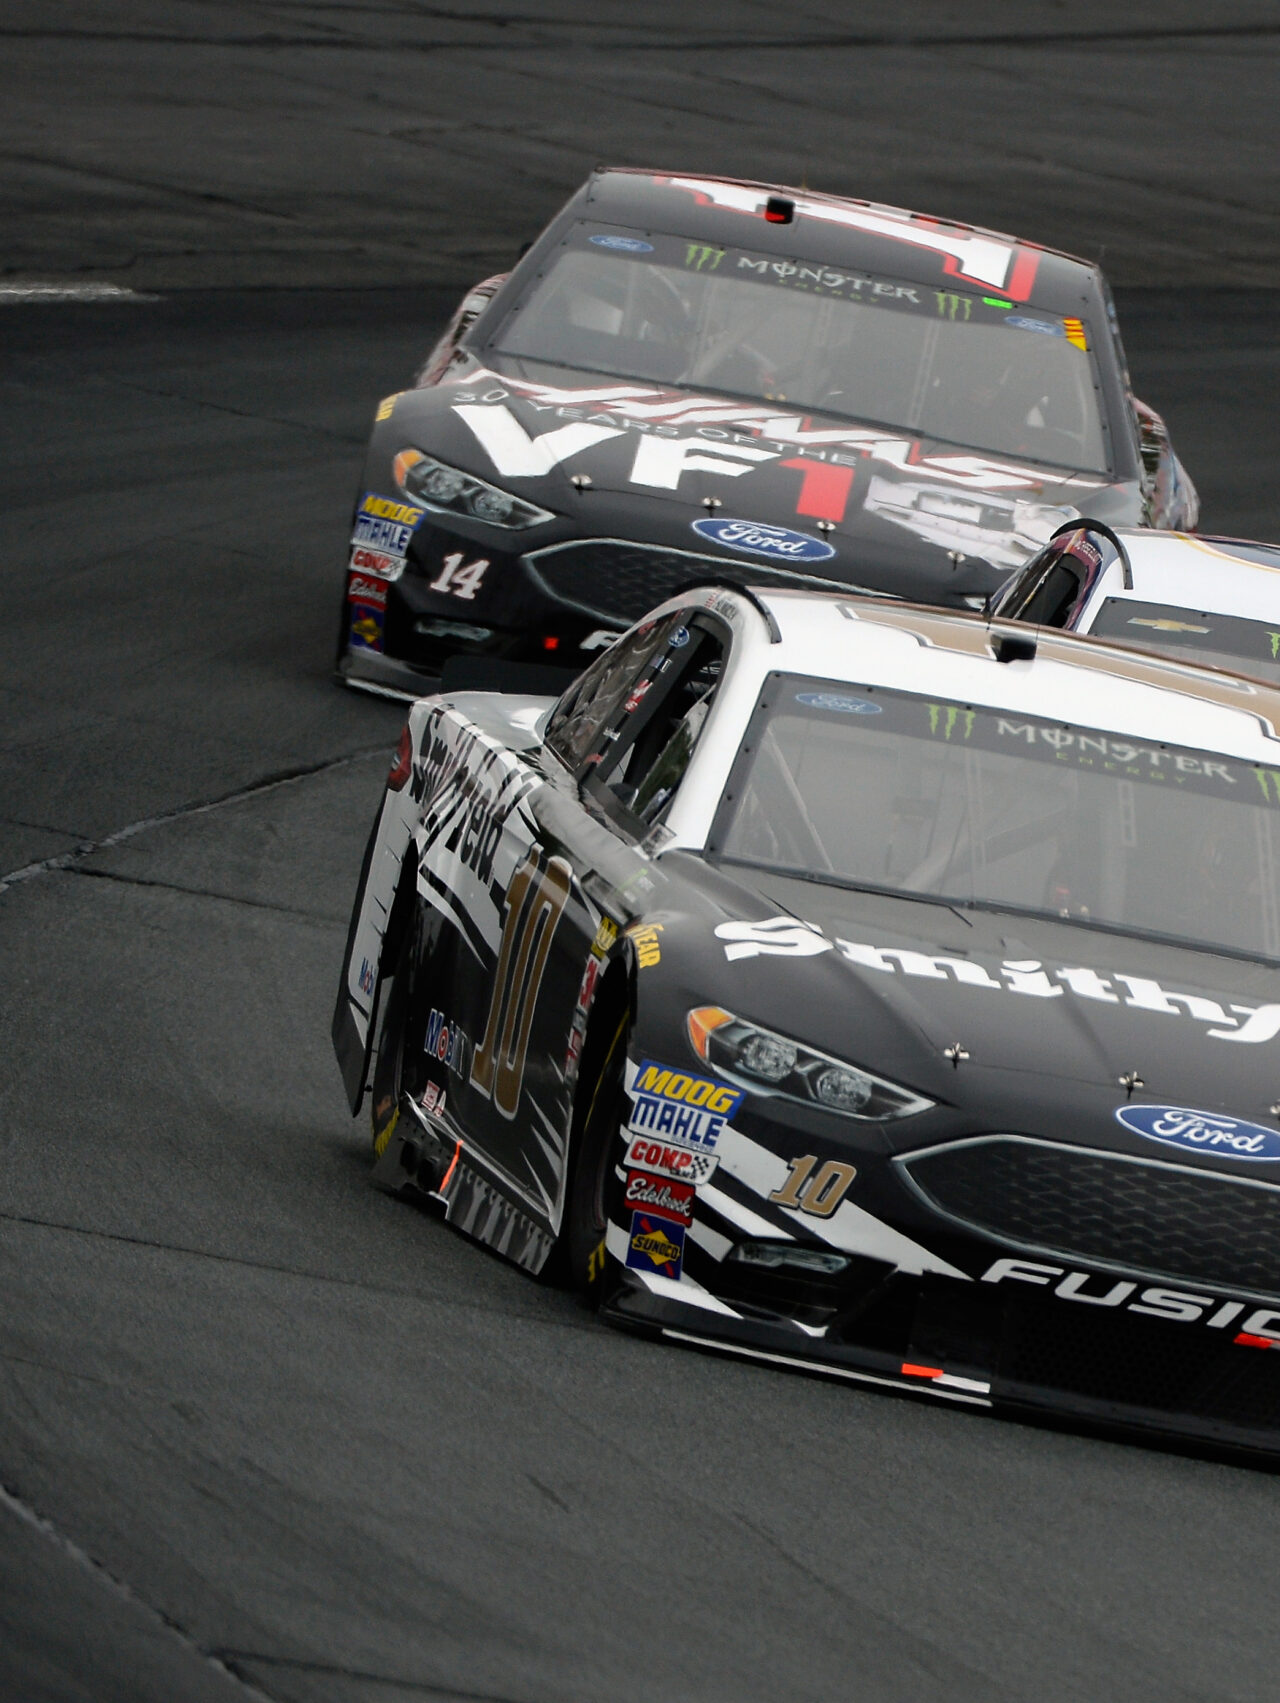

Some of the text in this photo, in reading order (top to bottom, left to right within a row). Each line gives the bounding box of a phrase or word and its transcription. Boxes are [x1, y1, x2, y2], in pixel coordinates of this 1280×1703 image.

[738, 256, 920, 303] MONSTER
[526, 399, 680, 437] YEARS
[696, 427, 757, 446] OF
[777, 442, 858, 467] THE
[362, 495, 424, 526] MOOG
[354, 518, 409, 552] MAHLE
[717, 519, 808, 554] Ford
[429, 553, 491, 600] 14
[996, 717, 1237, 783] MONSTER
[1055, 751, 1187, 784] ENERGY
[637, 1065, 741, 1114] MOOG
[632, 1096, 727, 1148] MAHLE
[1152, 1109, 1265, 1154] Ford
[630, 1140, 693, 1169] COMP
[626, 1178, 691, 1217] Edelbrock
[768, 1153, 858, 1219] 10
[633, 1235, 680, 1261] SUNOCO
